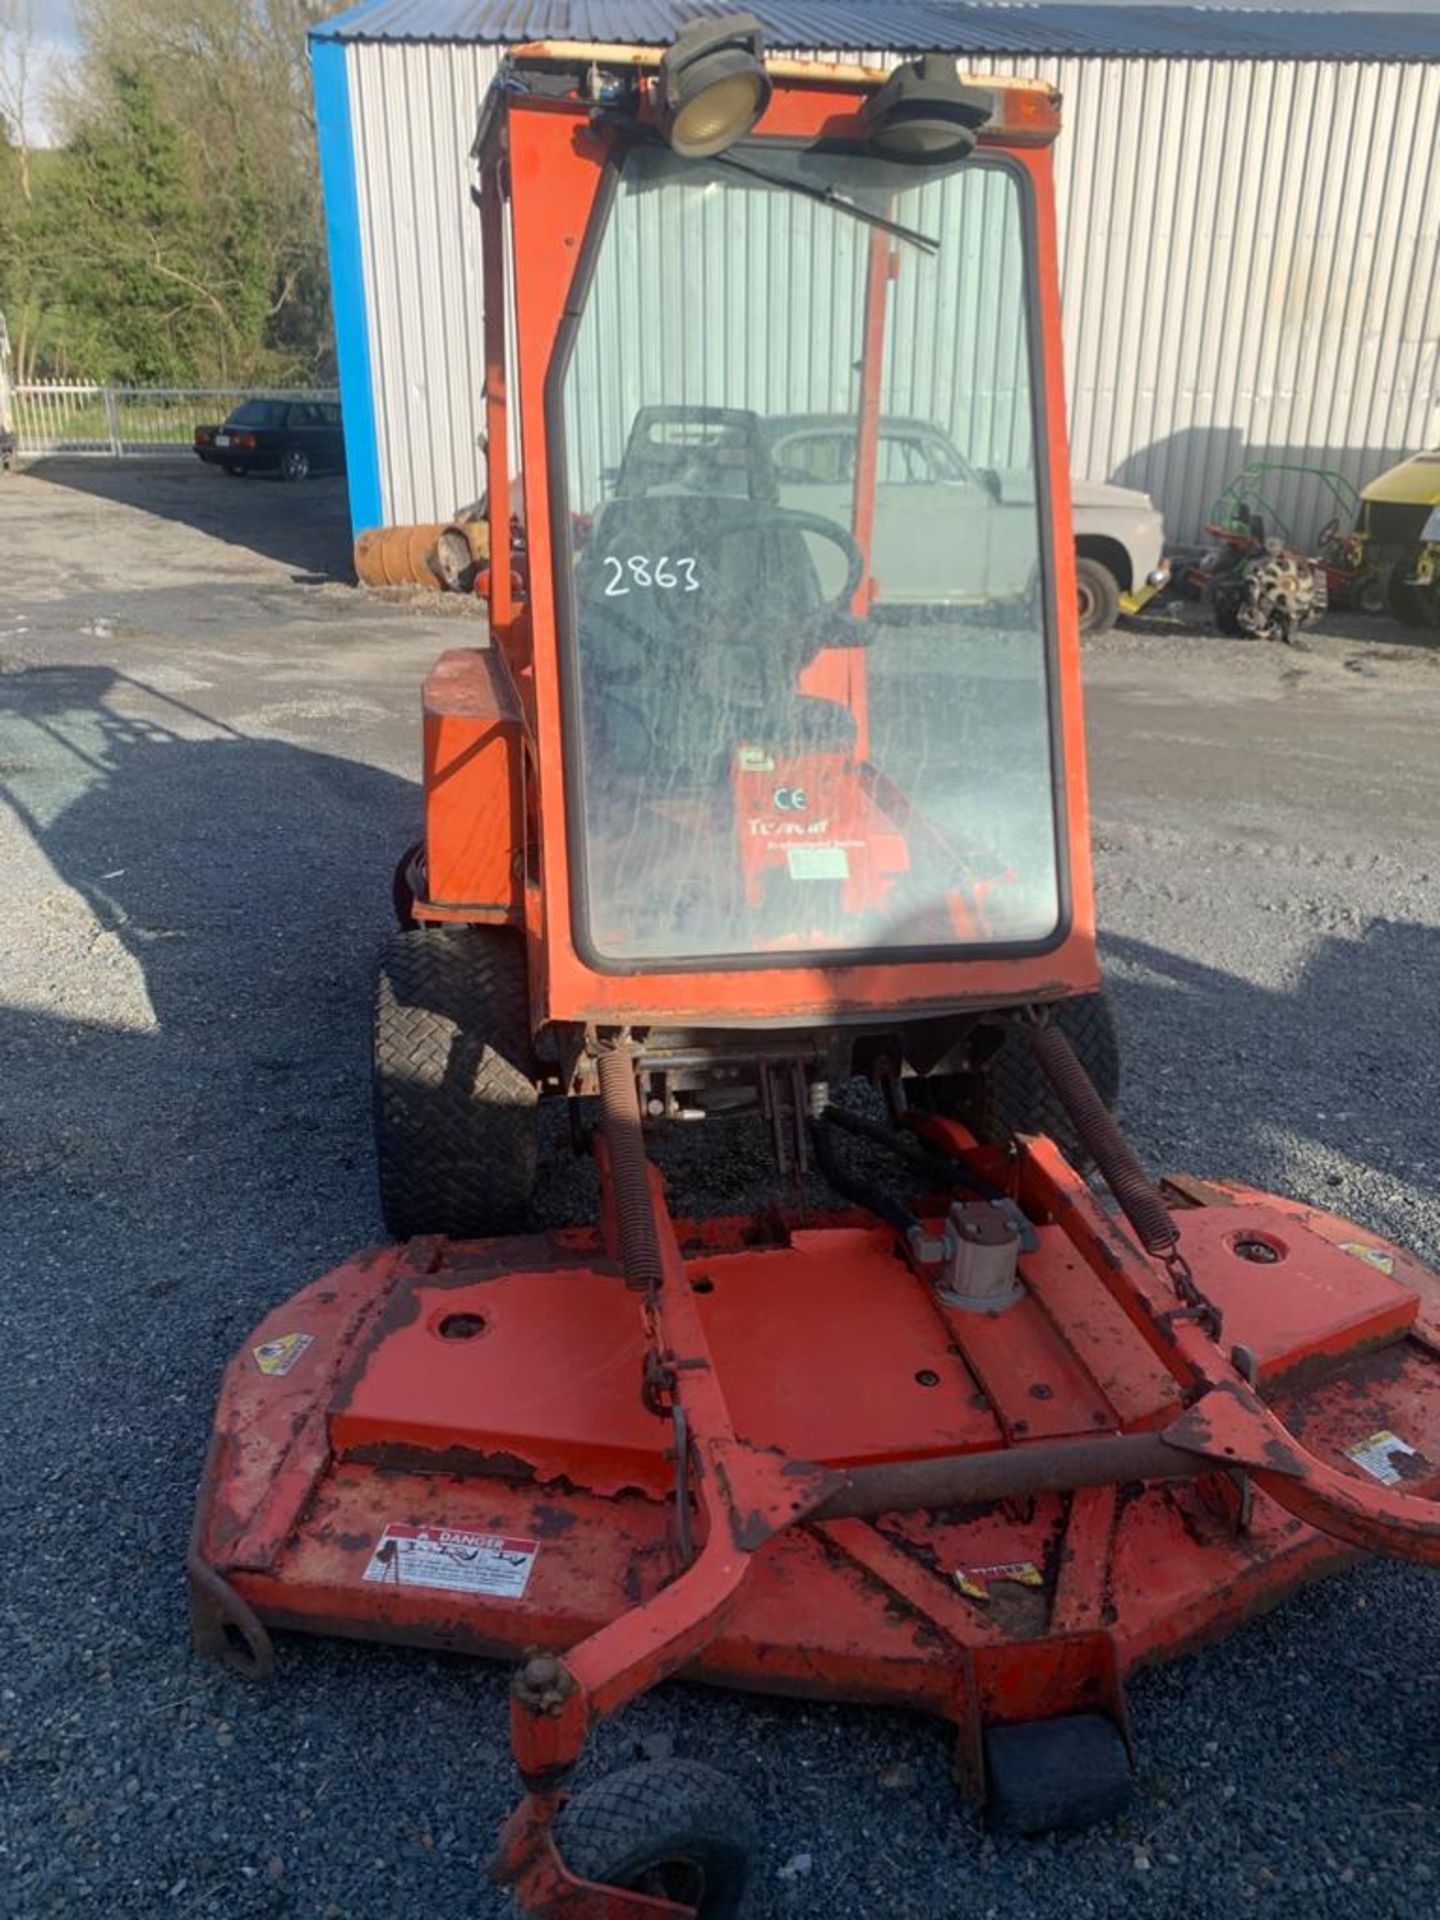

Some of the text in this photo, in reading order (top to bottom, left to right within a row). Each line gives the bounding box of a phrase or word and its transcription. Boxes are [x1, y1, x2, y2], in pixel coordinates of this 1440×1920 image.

[604, 556, 699, 596] 2863
[773, 787, 807, 811] CE
[439, 1530, 505, 1549] DANGER
